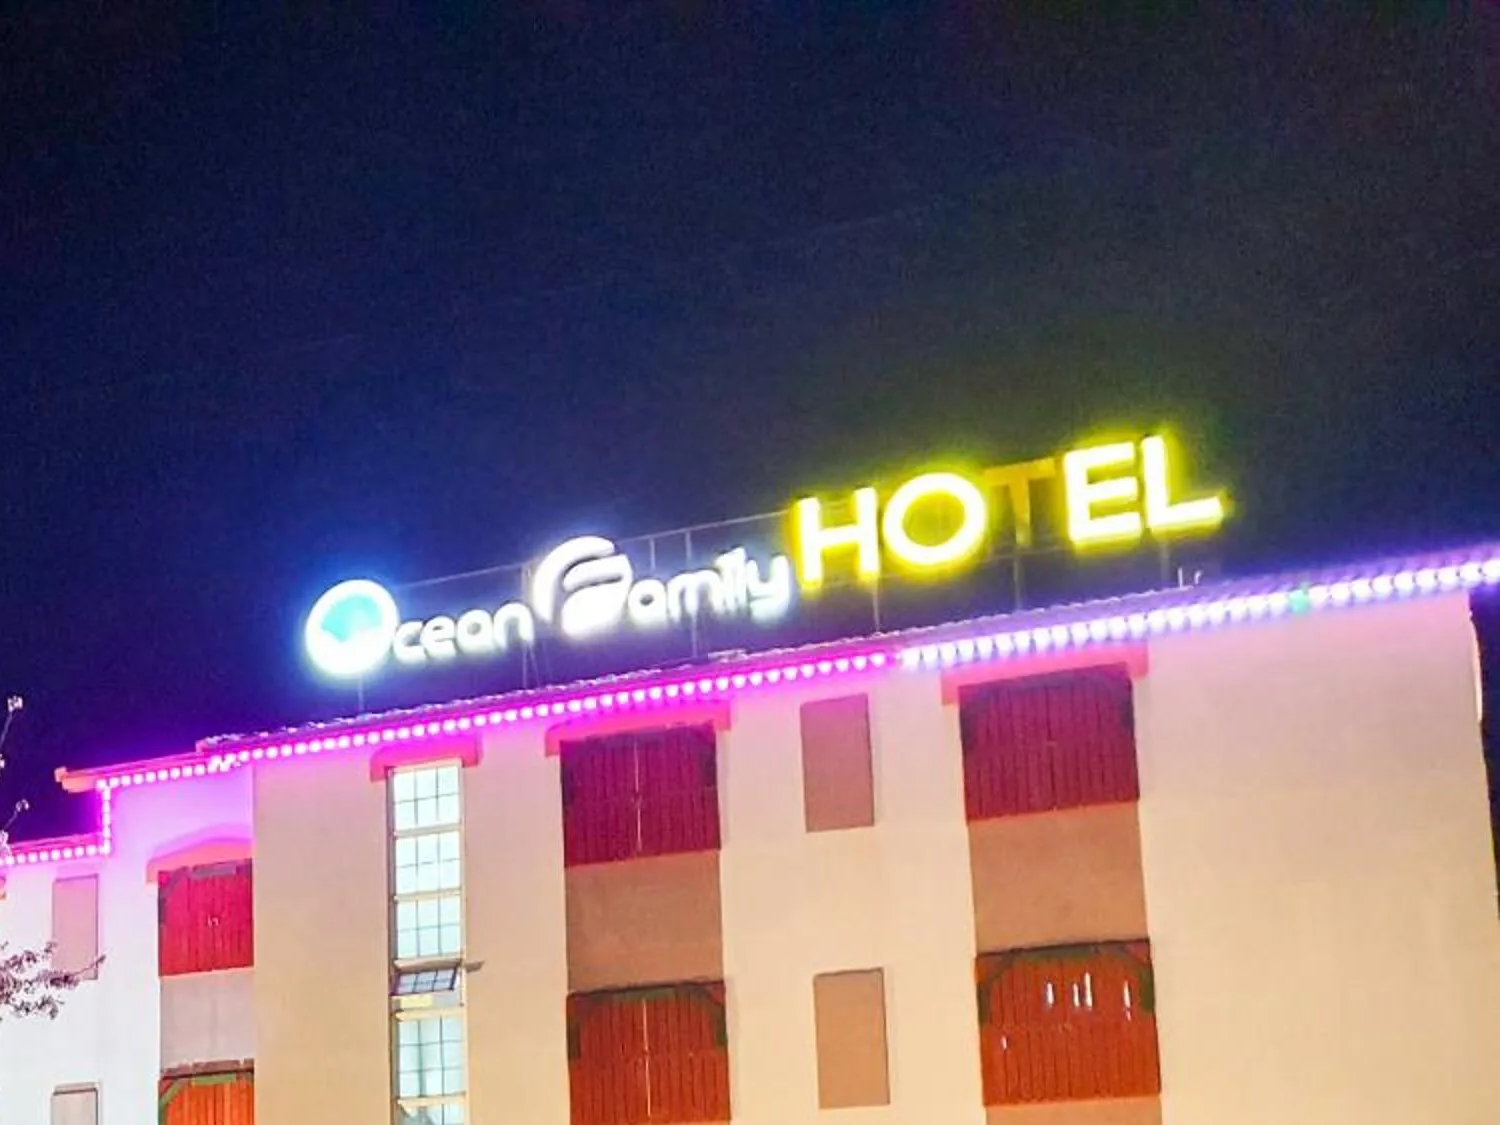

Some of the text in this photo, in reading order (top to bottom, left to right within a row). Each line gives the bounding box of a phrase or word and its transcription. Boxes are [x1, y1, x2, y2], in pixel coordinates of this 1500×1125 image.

[304, 433, 1225, 678] Ocean Family HOTEL
